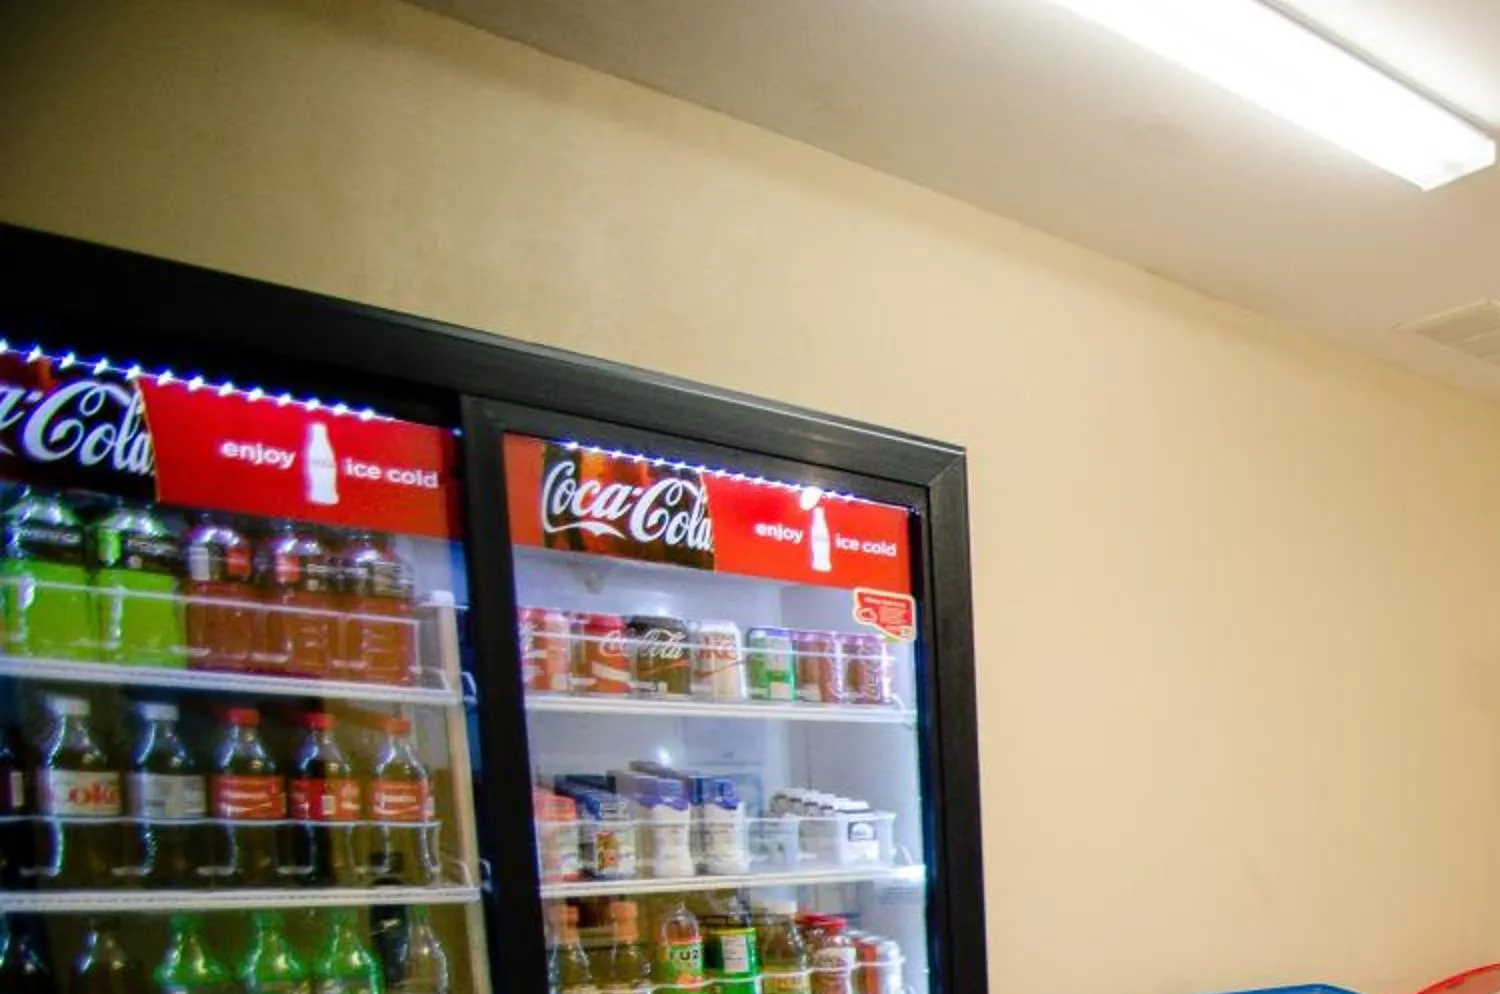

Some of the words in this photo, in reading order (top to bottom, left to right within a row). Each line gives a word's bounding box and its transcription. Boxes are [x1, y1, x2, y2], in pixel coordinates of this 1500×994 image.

[220, 440, 296, 469] enjoy
[346, 458, 382, 479] ice
[386, 468, 439, 488] cold
[541, 461, 714, 552] Coca-Cola
[755, 523, 803, 544] enjoy
[835, 533, 861, 551] ice
[863, 540, 897, 557] cold
